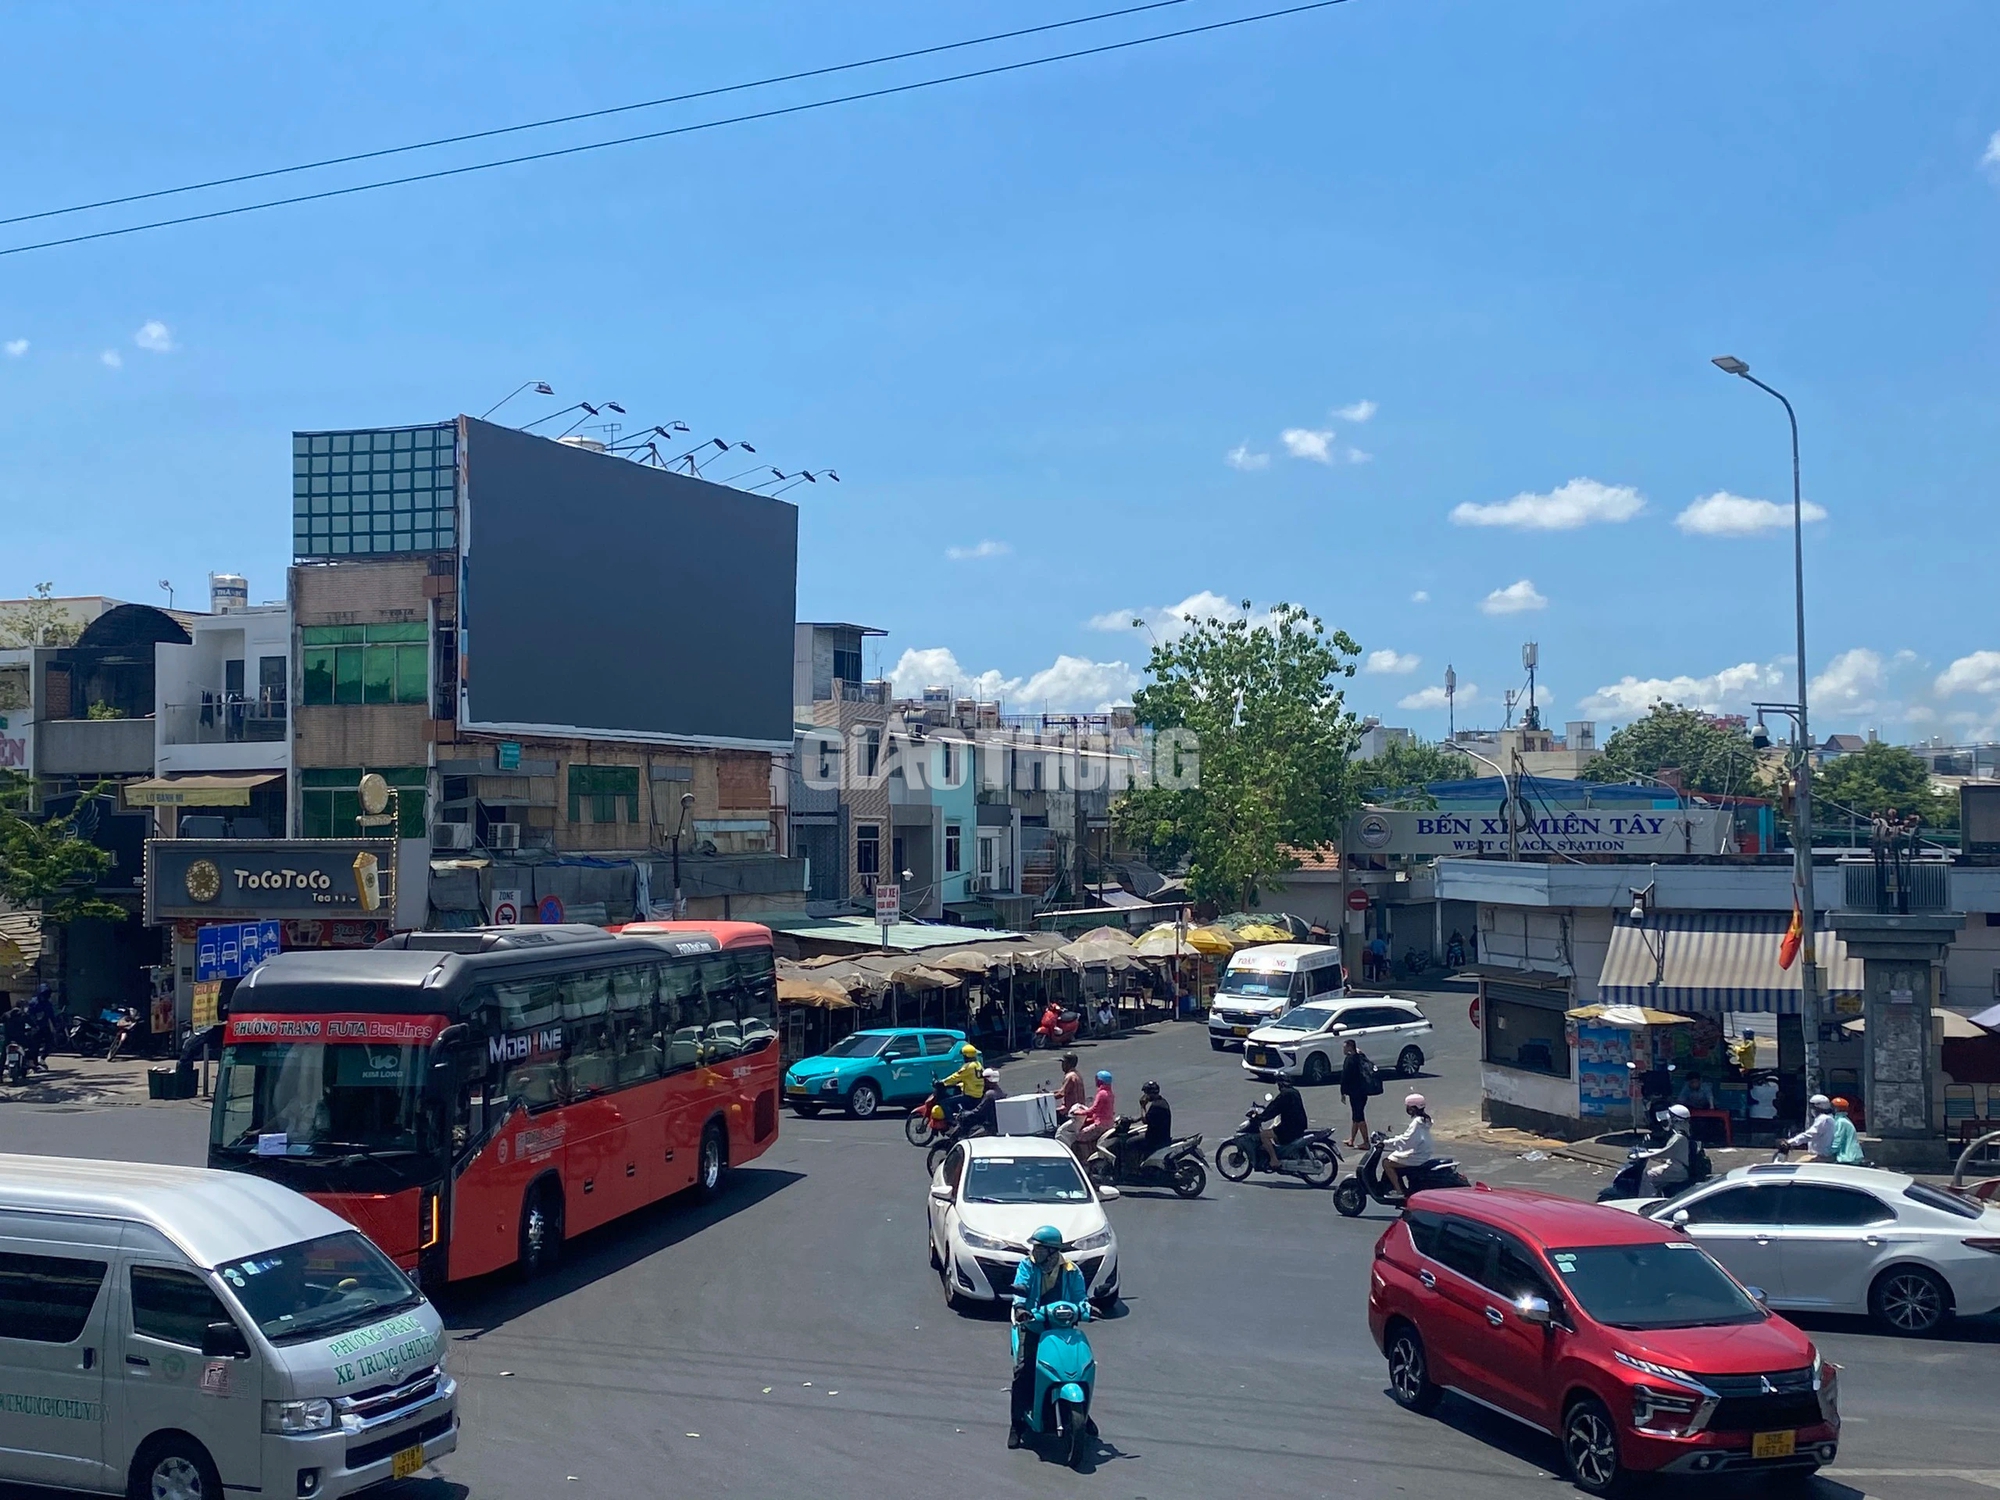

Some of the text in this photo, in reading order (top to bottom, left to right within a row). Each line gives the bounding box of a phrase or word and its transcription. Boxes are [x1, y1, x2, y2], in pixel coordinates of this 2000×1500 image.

[1416, 812, 1472, 835] BẾN
[1609, 812, 1665, 835] TÂY
[1557, 840, 1625, 851] STATION
[499, 890, 514, 901] ZONE
[279, 1020, 321, 1036] TRANG
[327, 1020, 368, 1037] FUTA
[369, 1021, 394, 1037] Bus
[394, 1022, 433, 1039] Lines
[380, 1070, 404, 1079] LONG
[379, 1315, 421, 1337] TRANG
[334, 1362, 356, 1386] XE
[356, 1346, 398, 1378] TRUNG
[6, 1393, 52, 1416] TRUNG
